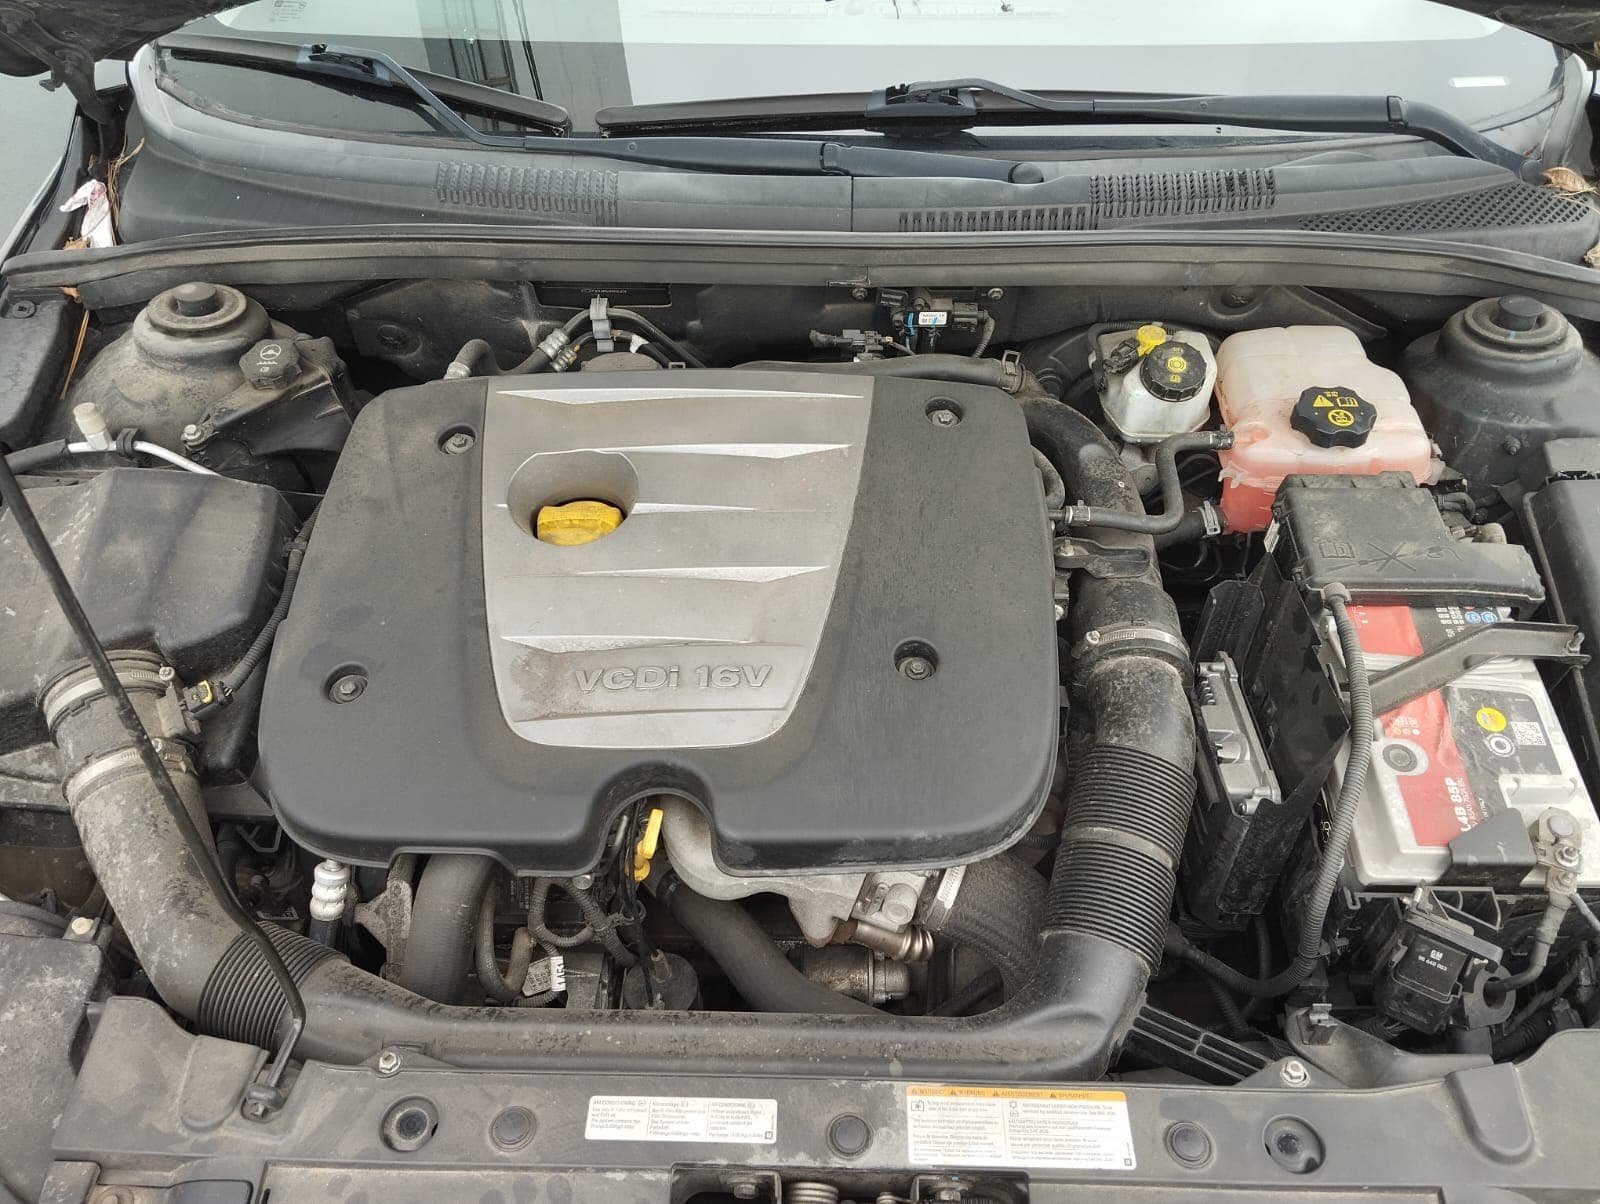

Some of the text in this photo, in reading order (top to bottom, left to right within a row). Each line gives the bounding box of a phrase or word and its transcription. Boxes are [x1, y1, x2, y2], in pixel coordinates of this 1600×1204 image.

[575, 664, 773, 694] VCDi 16V
[1444, 776, 1463, 803] 85P
